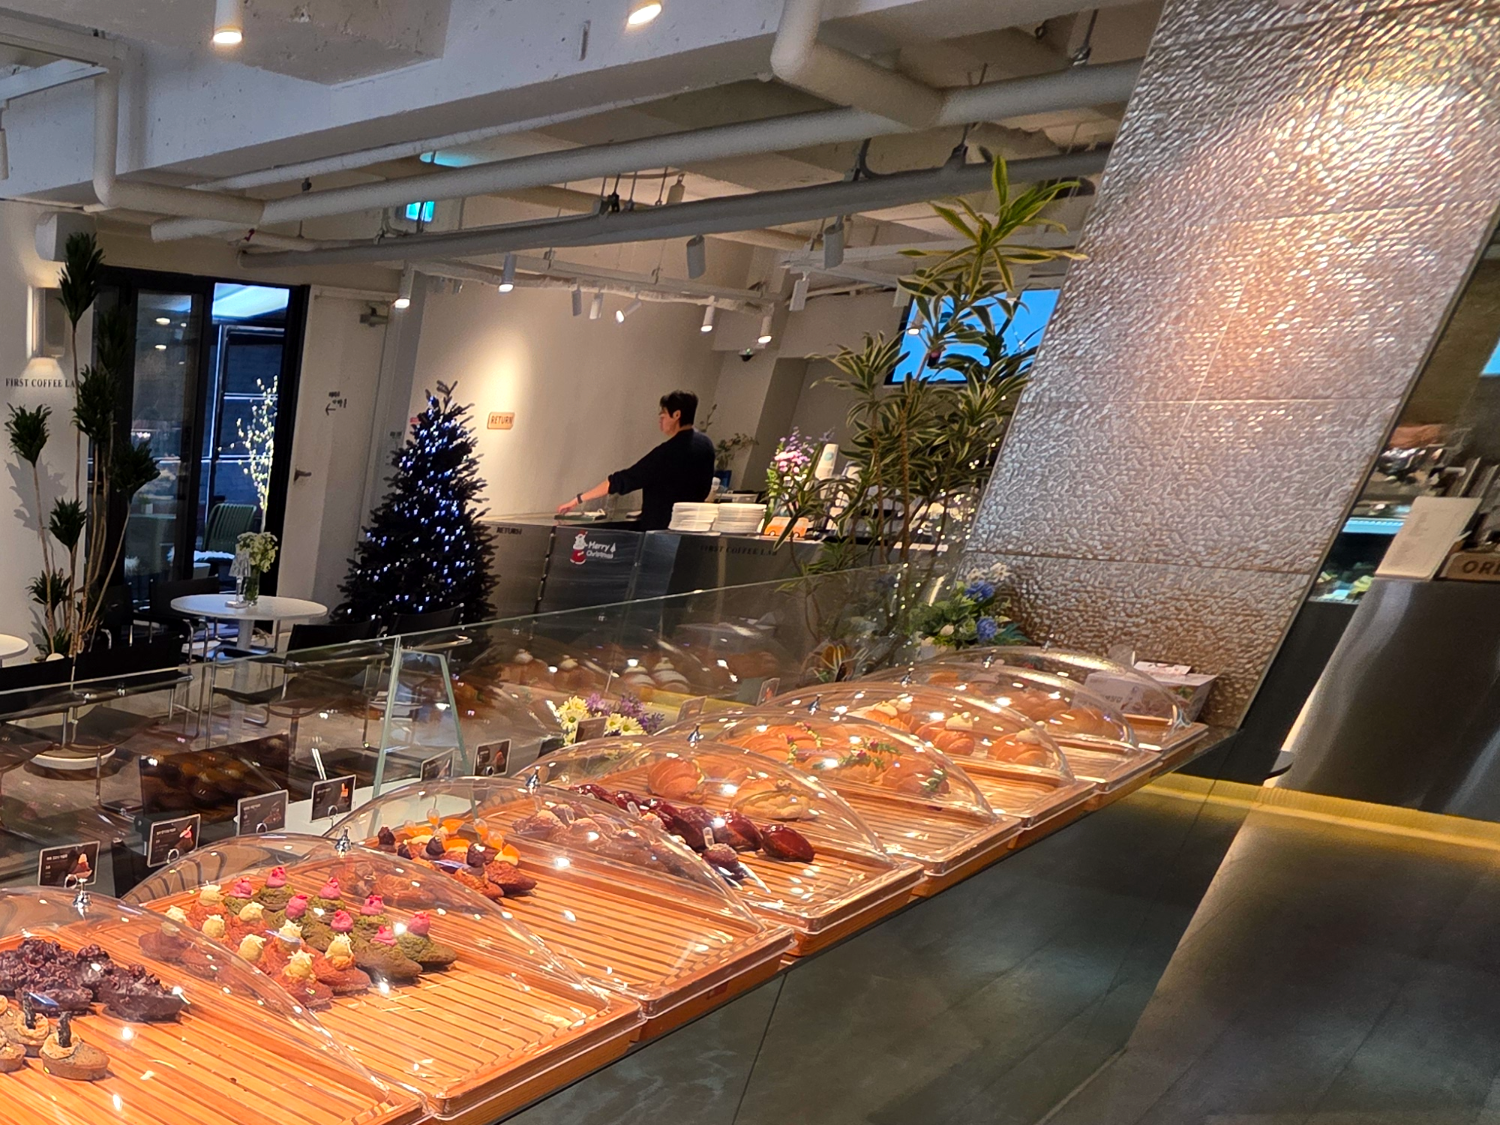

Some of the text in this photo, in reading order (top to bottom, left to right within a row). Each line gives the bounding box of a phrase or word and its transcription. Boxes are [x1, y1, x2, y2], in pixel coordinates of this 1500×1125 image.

[5, 378, 29, 388] FIRST
[31, 378, 63, 388] COFFEE
[490, 415, 513, 424] RETURN
[496, 526, 522, 535] RETURN
[588, 541, 610, 552] Merry
